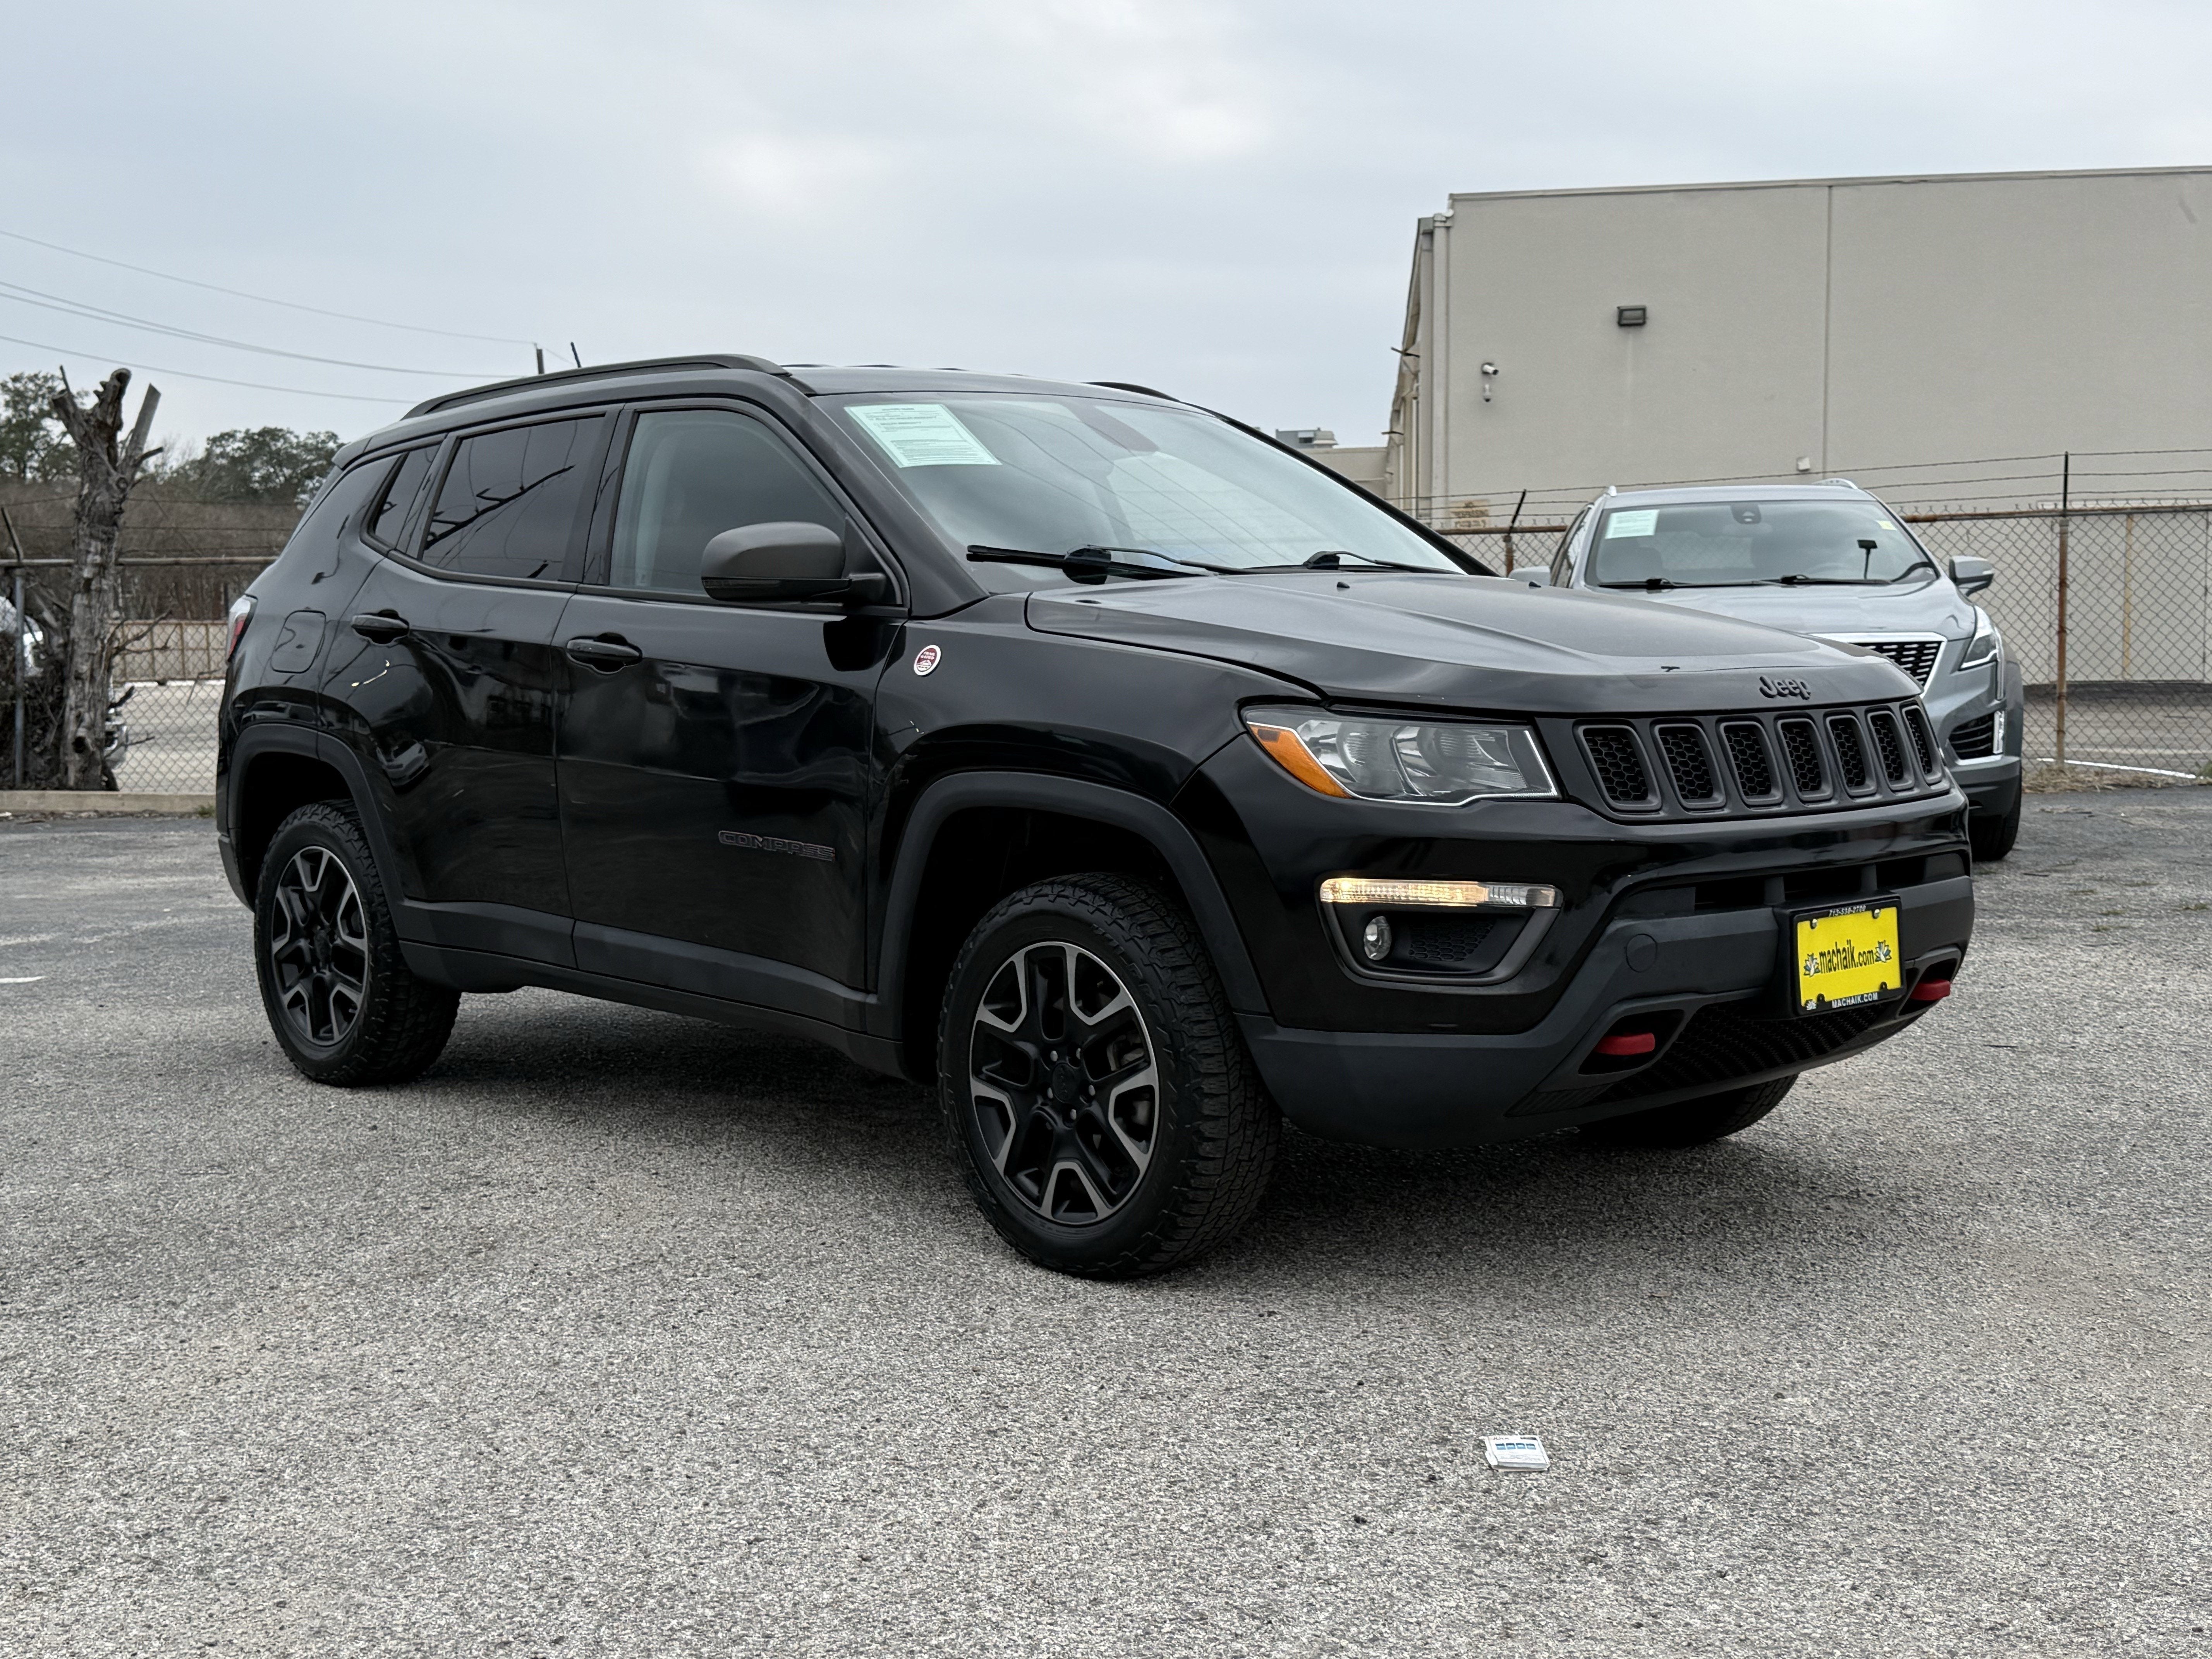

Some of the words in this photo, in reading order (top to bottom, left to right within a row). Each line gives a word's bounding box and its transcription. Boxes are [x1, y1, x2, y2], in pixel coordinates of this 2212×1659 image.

[1759, 675, 1811, 700] Jeep
[1819, 939, 1875, 974] machaik.com
[1832, 992, 1878, 1008] MACHAIK.COM
